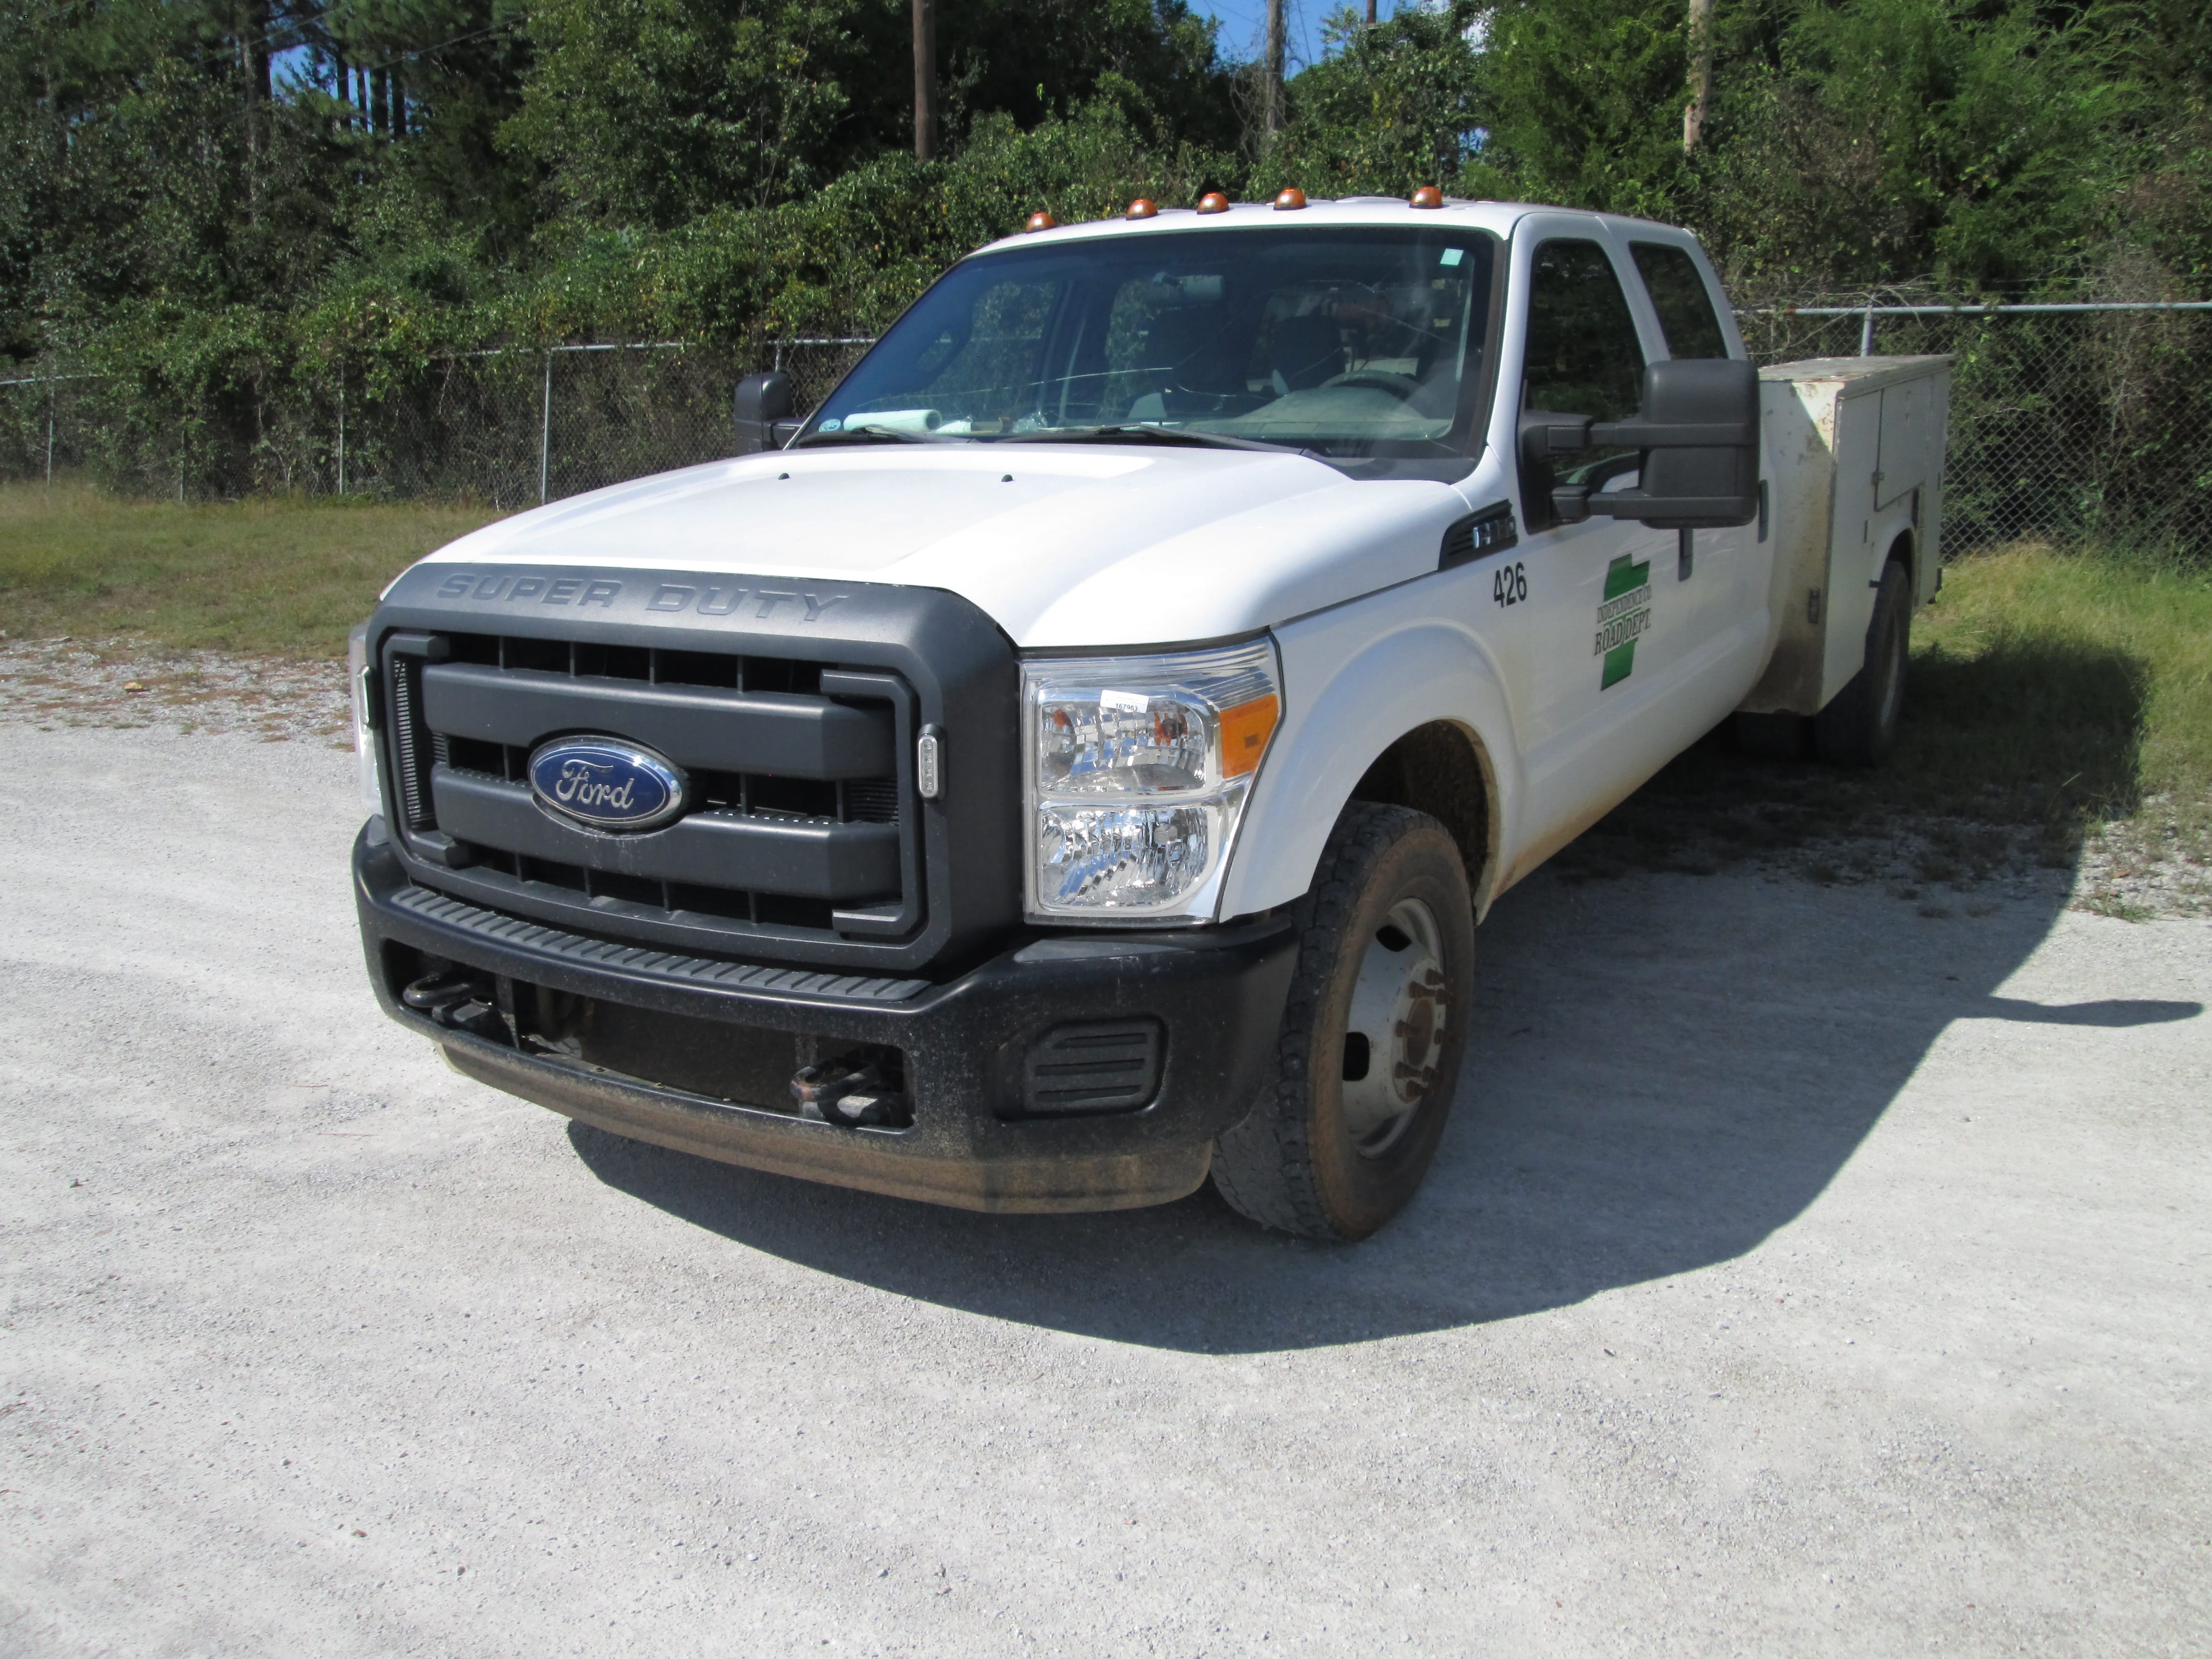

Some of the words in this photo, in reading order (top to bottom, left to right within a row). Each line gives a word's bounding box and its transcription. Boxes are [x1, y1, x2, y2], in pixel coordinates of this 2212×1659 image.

[436, 573, 623, 607] SUPER
[645, 583, 849, 621] DUTY
[1494, 562, 1527, 608] 426
[1594, 622, 1623, 656] ROAD
[1116, 703, 1138, 711] 167963
[555, 759, 635, 809] Ford
